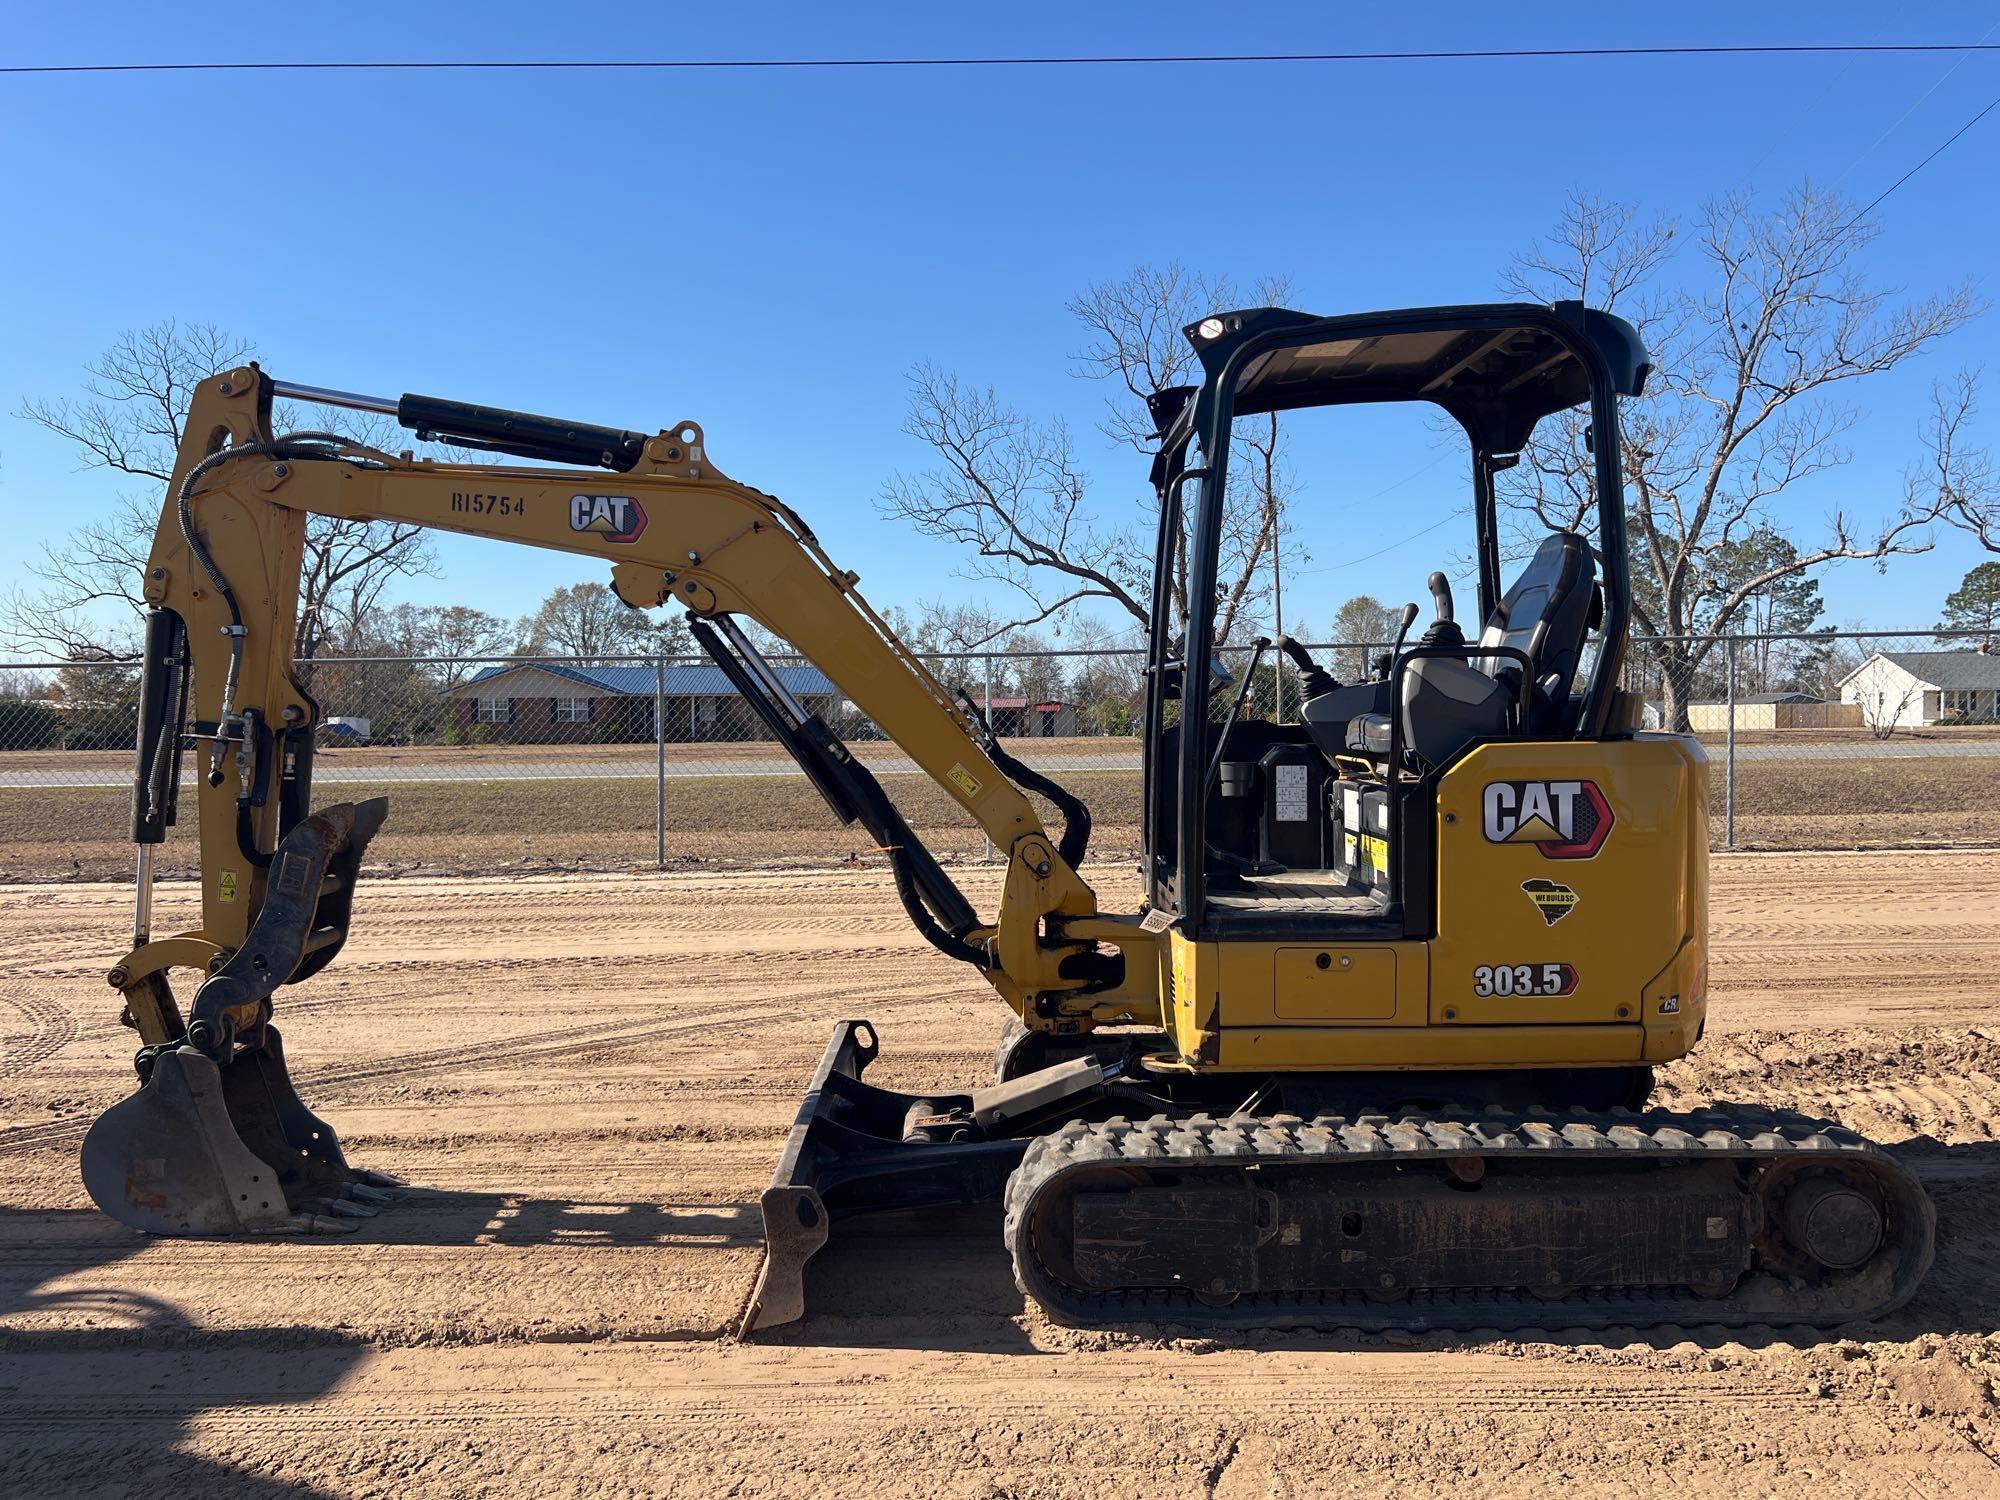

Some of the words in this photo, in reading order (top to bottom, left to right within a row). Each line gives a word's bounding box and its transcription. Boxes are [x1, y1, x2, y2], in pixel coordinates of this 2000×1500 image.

[570, 495, 629, 532] CAT
[1484, 782, 1581, 841] CAT
[1536, 894, 1546, 902] WE
[1547, 894, 1565, 902] BUILD
[1565, 894, 1574, 902] SC
[1475, 964, 1561, 996] 303.5
[1664, 998, 1677, 1011] CR
